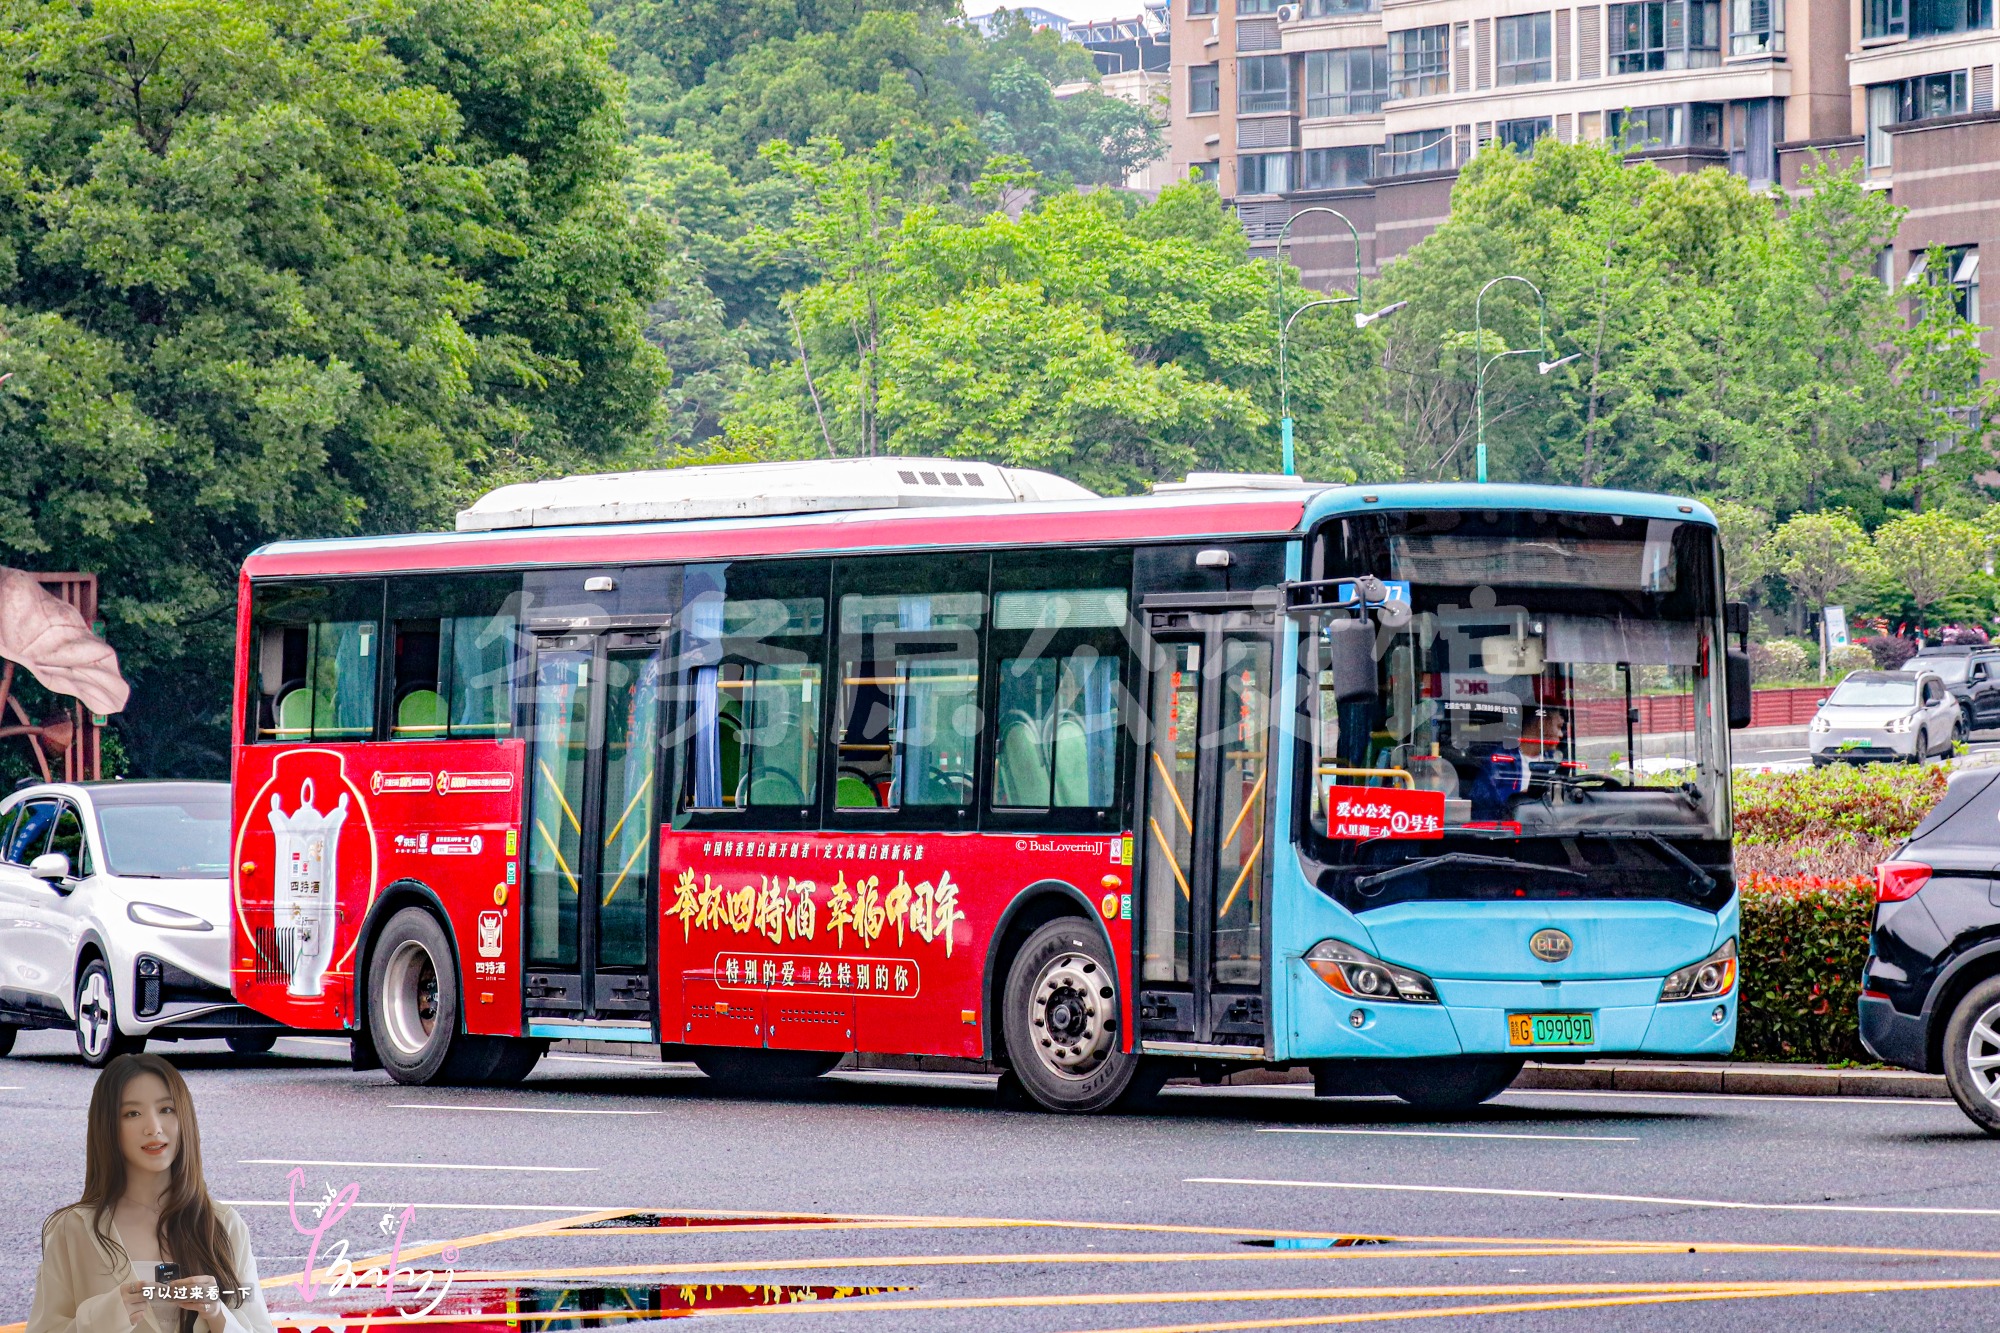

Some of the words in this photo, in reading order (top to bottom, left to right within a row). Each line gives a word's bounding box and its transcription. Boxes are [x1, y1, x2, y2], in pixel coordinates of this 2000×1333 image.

[1336, 801, 1392, 819] 爱心公交
[1336, 823, 1391, 838] 八里湖三小
[703, 841, 810, 858] 中国特香型白酒开创者
[823, 843, 925, 860] 定义高端白酒新标准
[290, 881, 320, 894] 四特酒
[475, 962, 506, 974] 四特酒
[725, 957, 796, 987] 特别的爱
[818, 961, 909, 992] 给特别的你
